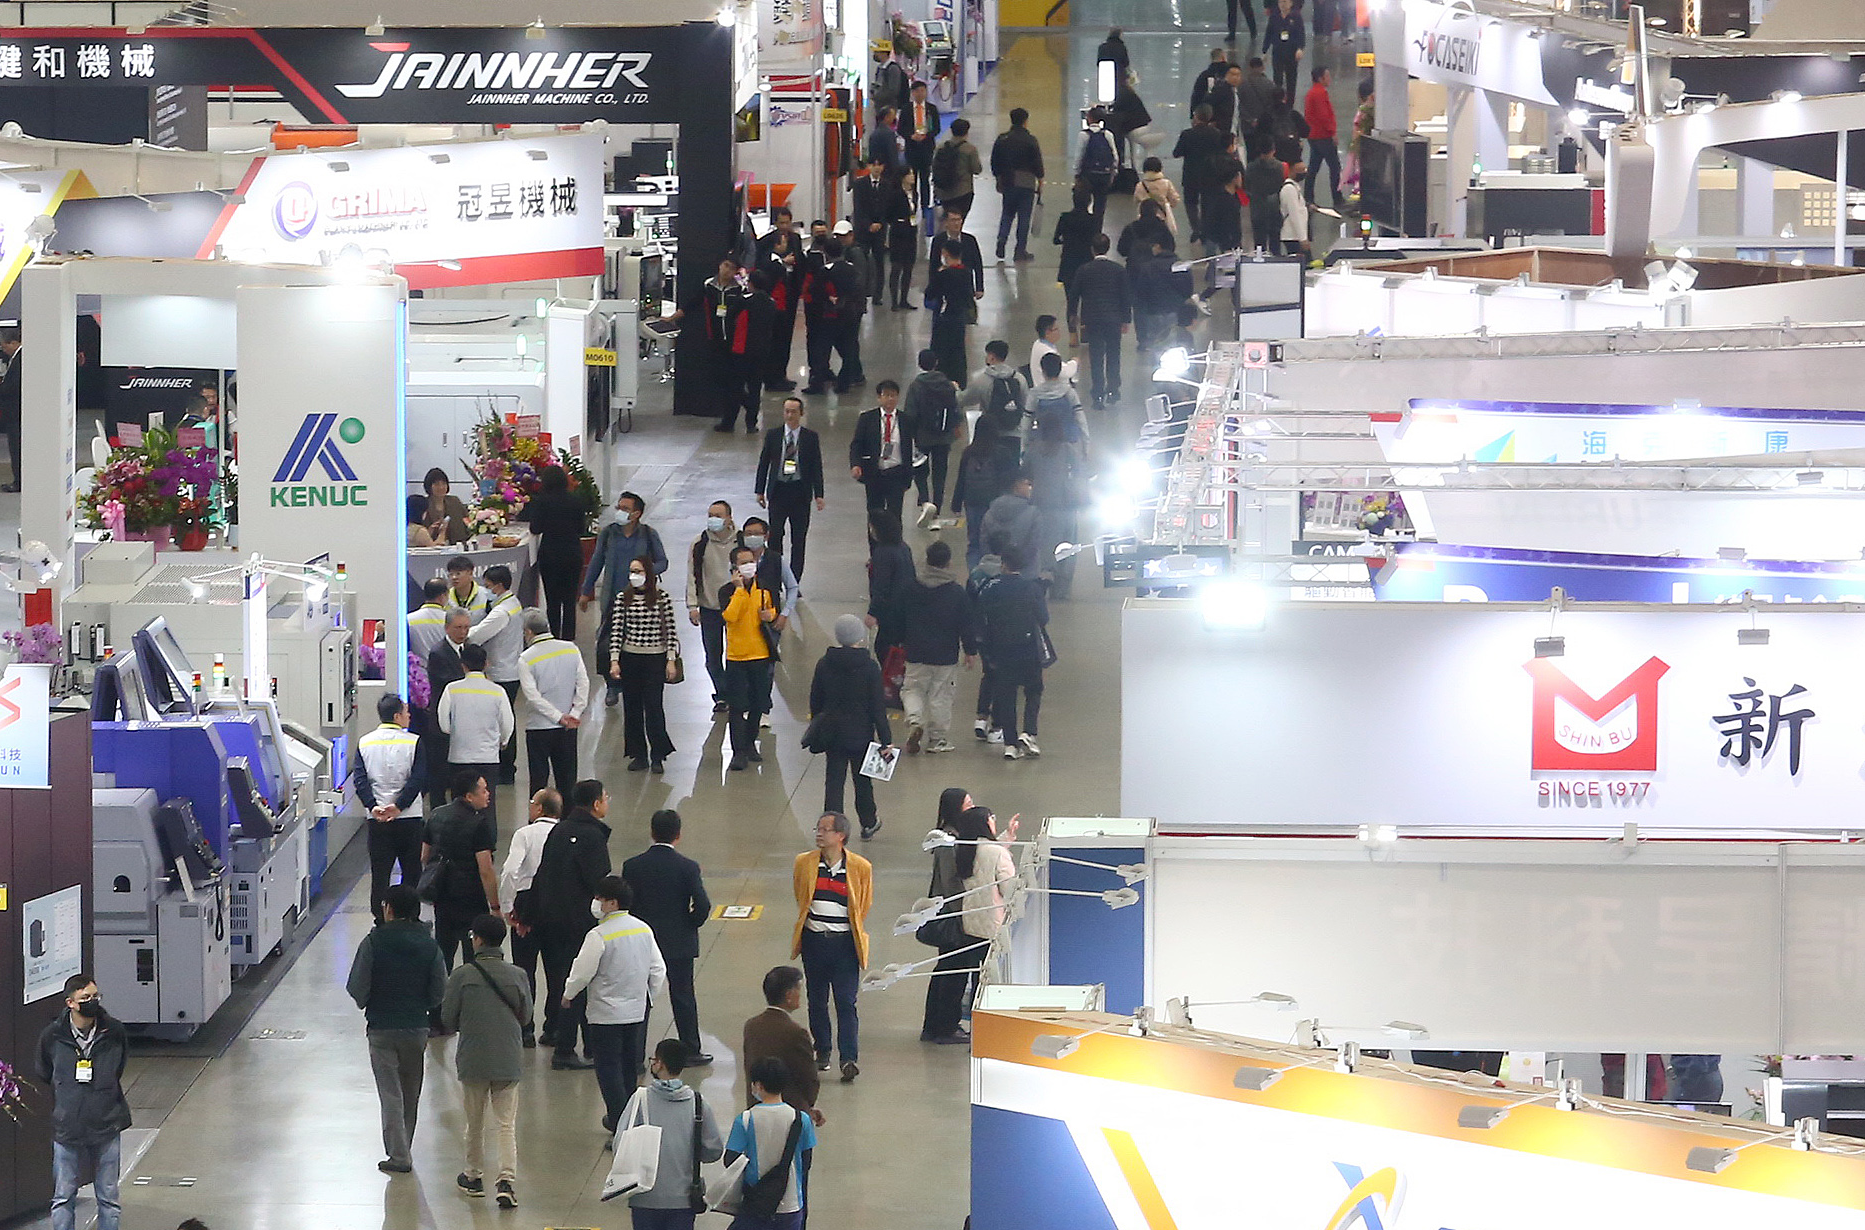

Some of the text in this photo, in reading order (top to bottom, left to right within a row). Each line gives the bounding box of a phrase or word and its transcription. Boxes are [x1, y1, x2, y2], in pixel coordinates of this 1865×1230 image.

[334, 42, 652, 99] JAINNHER
[466, 92, 529, 105] JAINNHER
[532, 92, 590, 105] MACHINE
[623, 92, 650, 104] LTD.
[119, 376, 194, 391] JAINNHER
[270, 485, 369, 507] KENUC
[1711, 676, 1816, 778] 新
[1538, 781, 1651, 797] SINCE 1977
